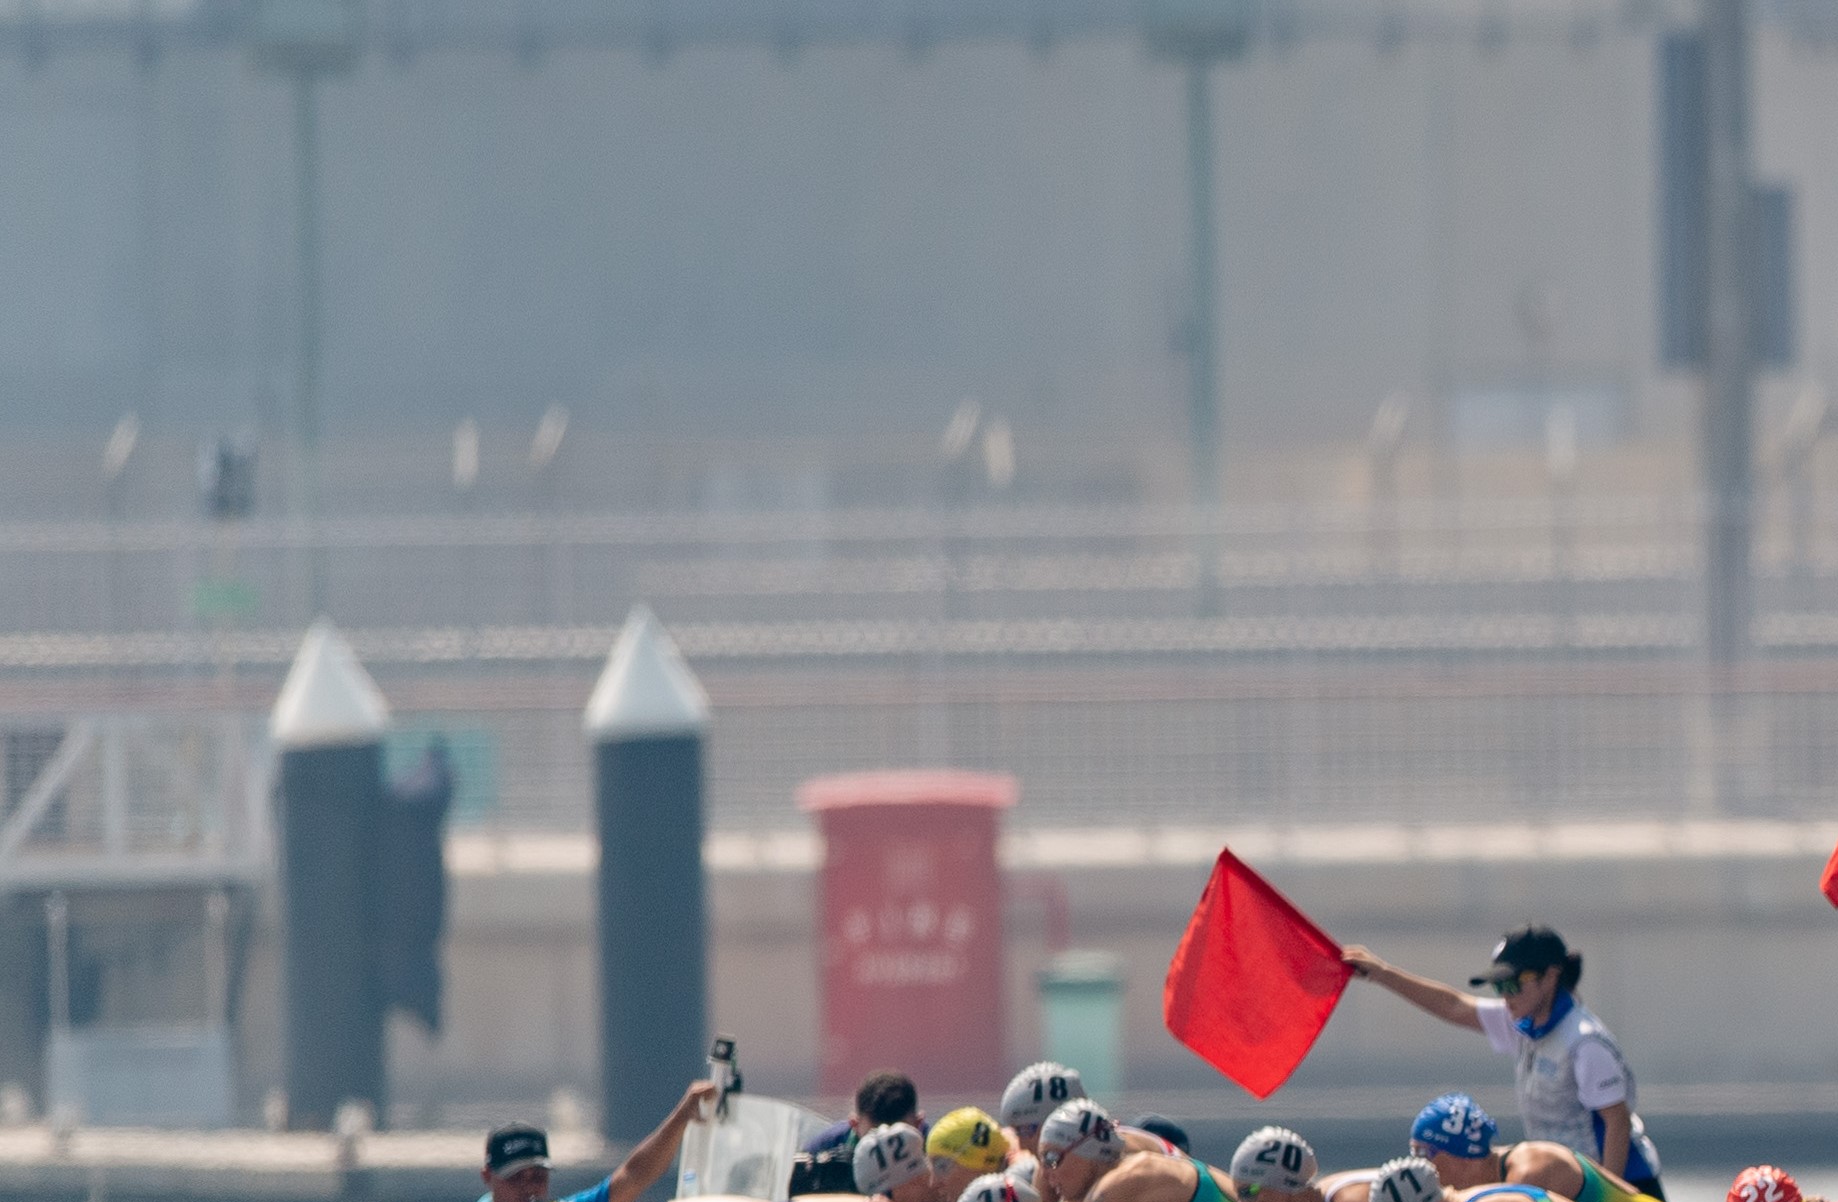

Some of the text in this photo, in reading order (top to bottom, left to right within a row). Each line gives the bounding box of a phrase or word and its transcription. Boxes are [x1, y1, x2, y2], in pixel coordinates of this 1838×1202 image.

[1029, 1076, 1068, 1105] 18
[971, 1121, 991, 1148] 8
[868, 1134, 907, 1172] 12
[1255, 1140, 1303, 1173] 20
